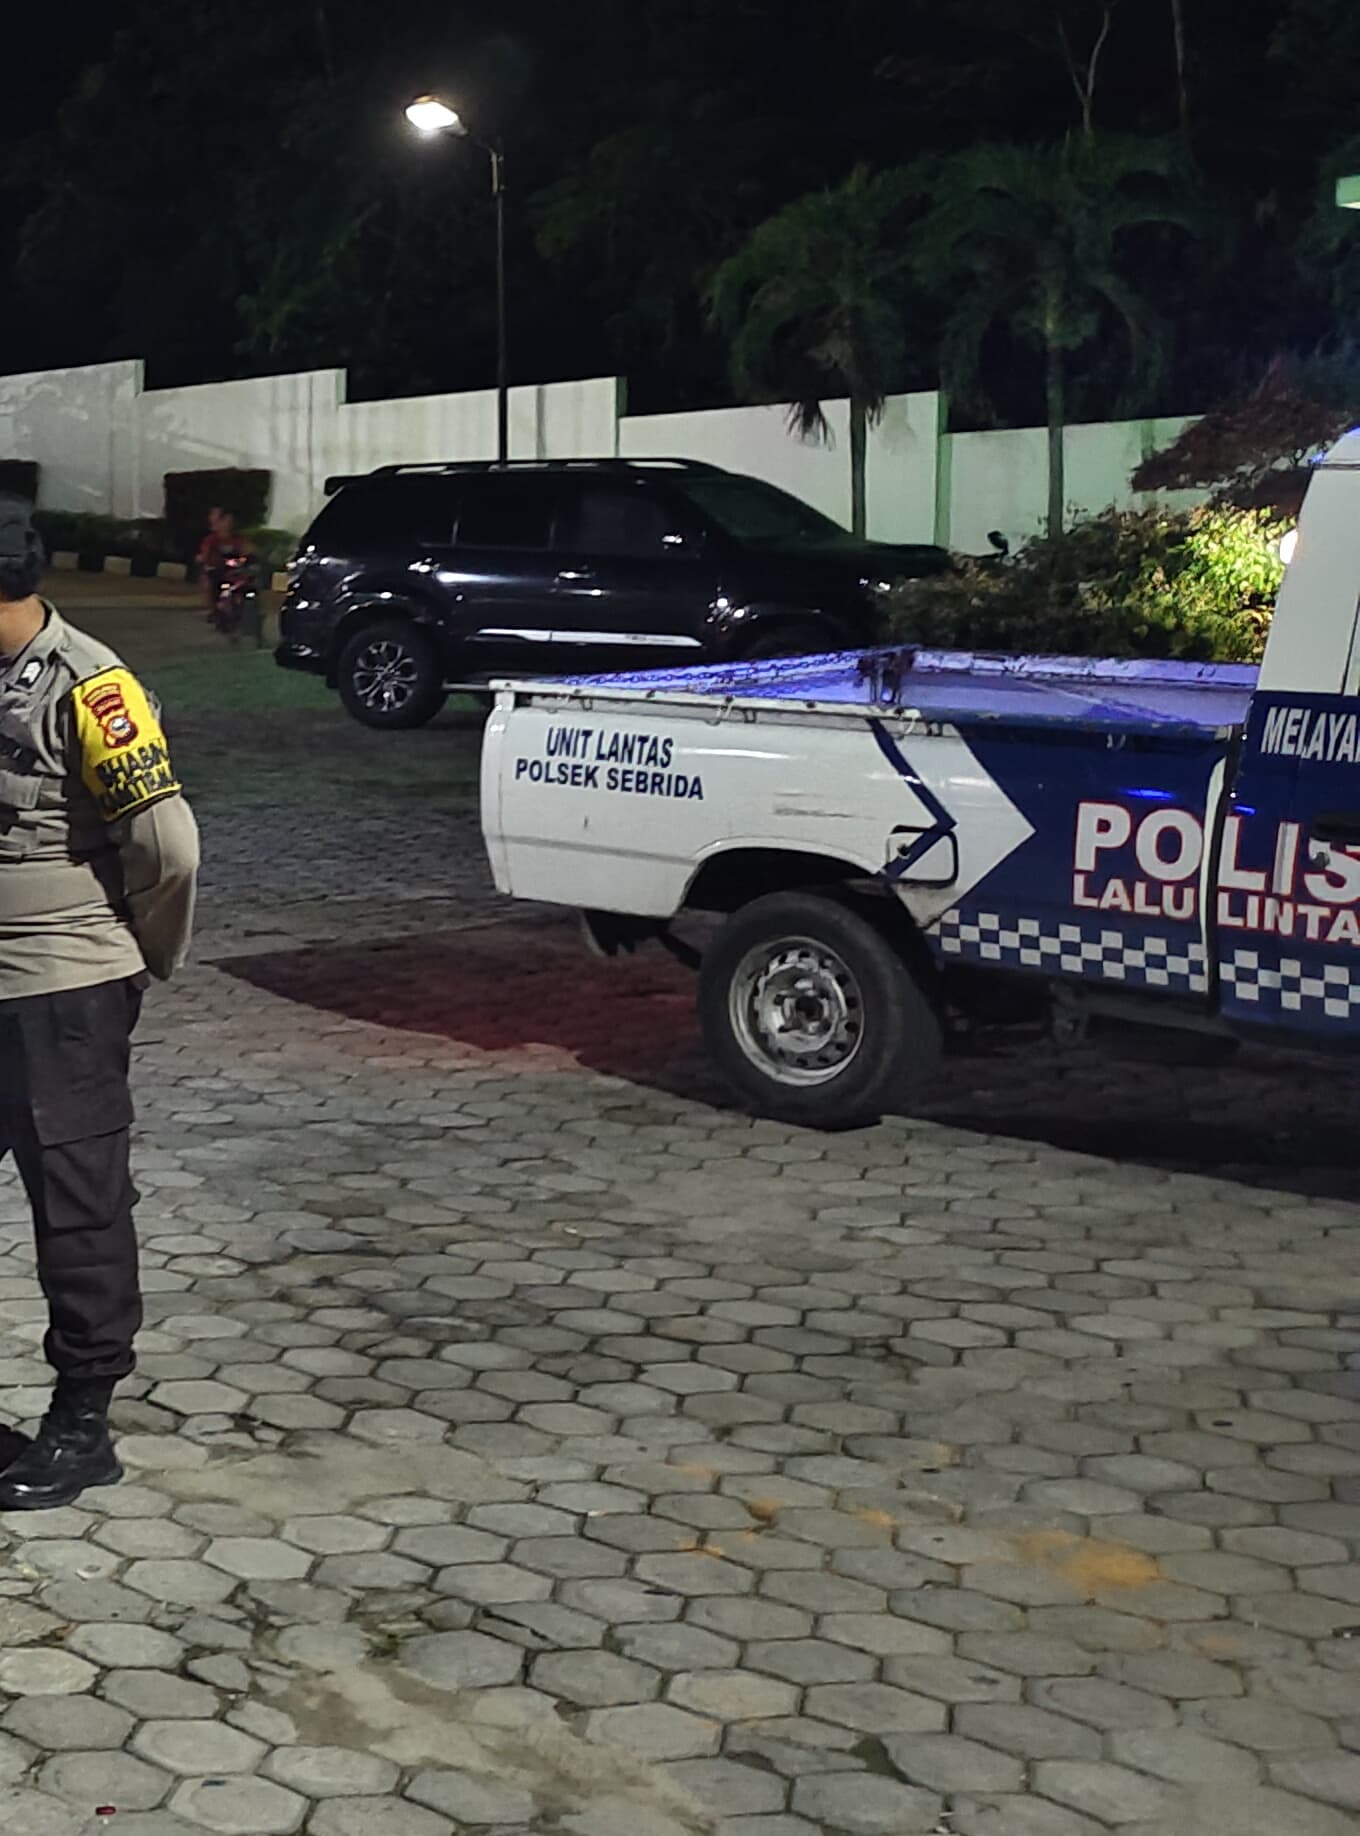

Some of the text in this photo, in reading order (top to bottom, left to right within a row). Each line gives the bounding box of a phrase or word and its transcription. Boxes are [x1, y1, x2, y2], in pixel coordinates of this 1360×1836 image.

[546, 726, 674, 769] UNIT LANTAS
[515, 758, 704, 801] POLSEK SEBRIDA
[1073, 873, 1360, 946] LALU LINTA
